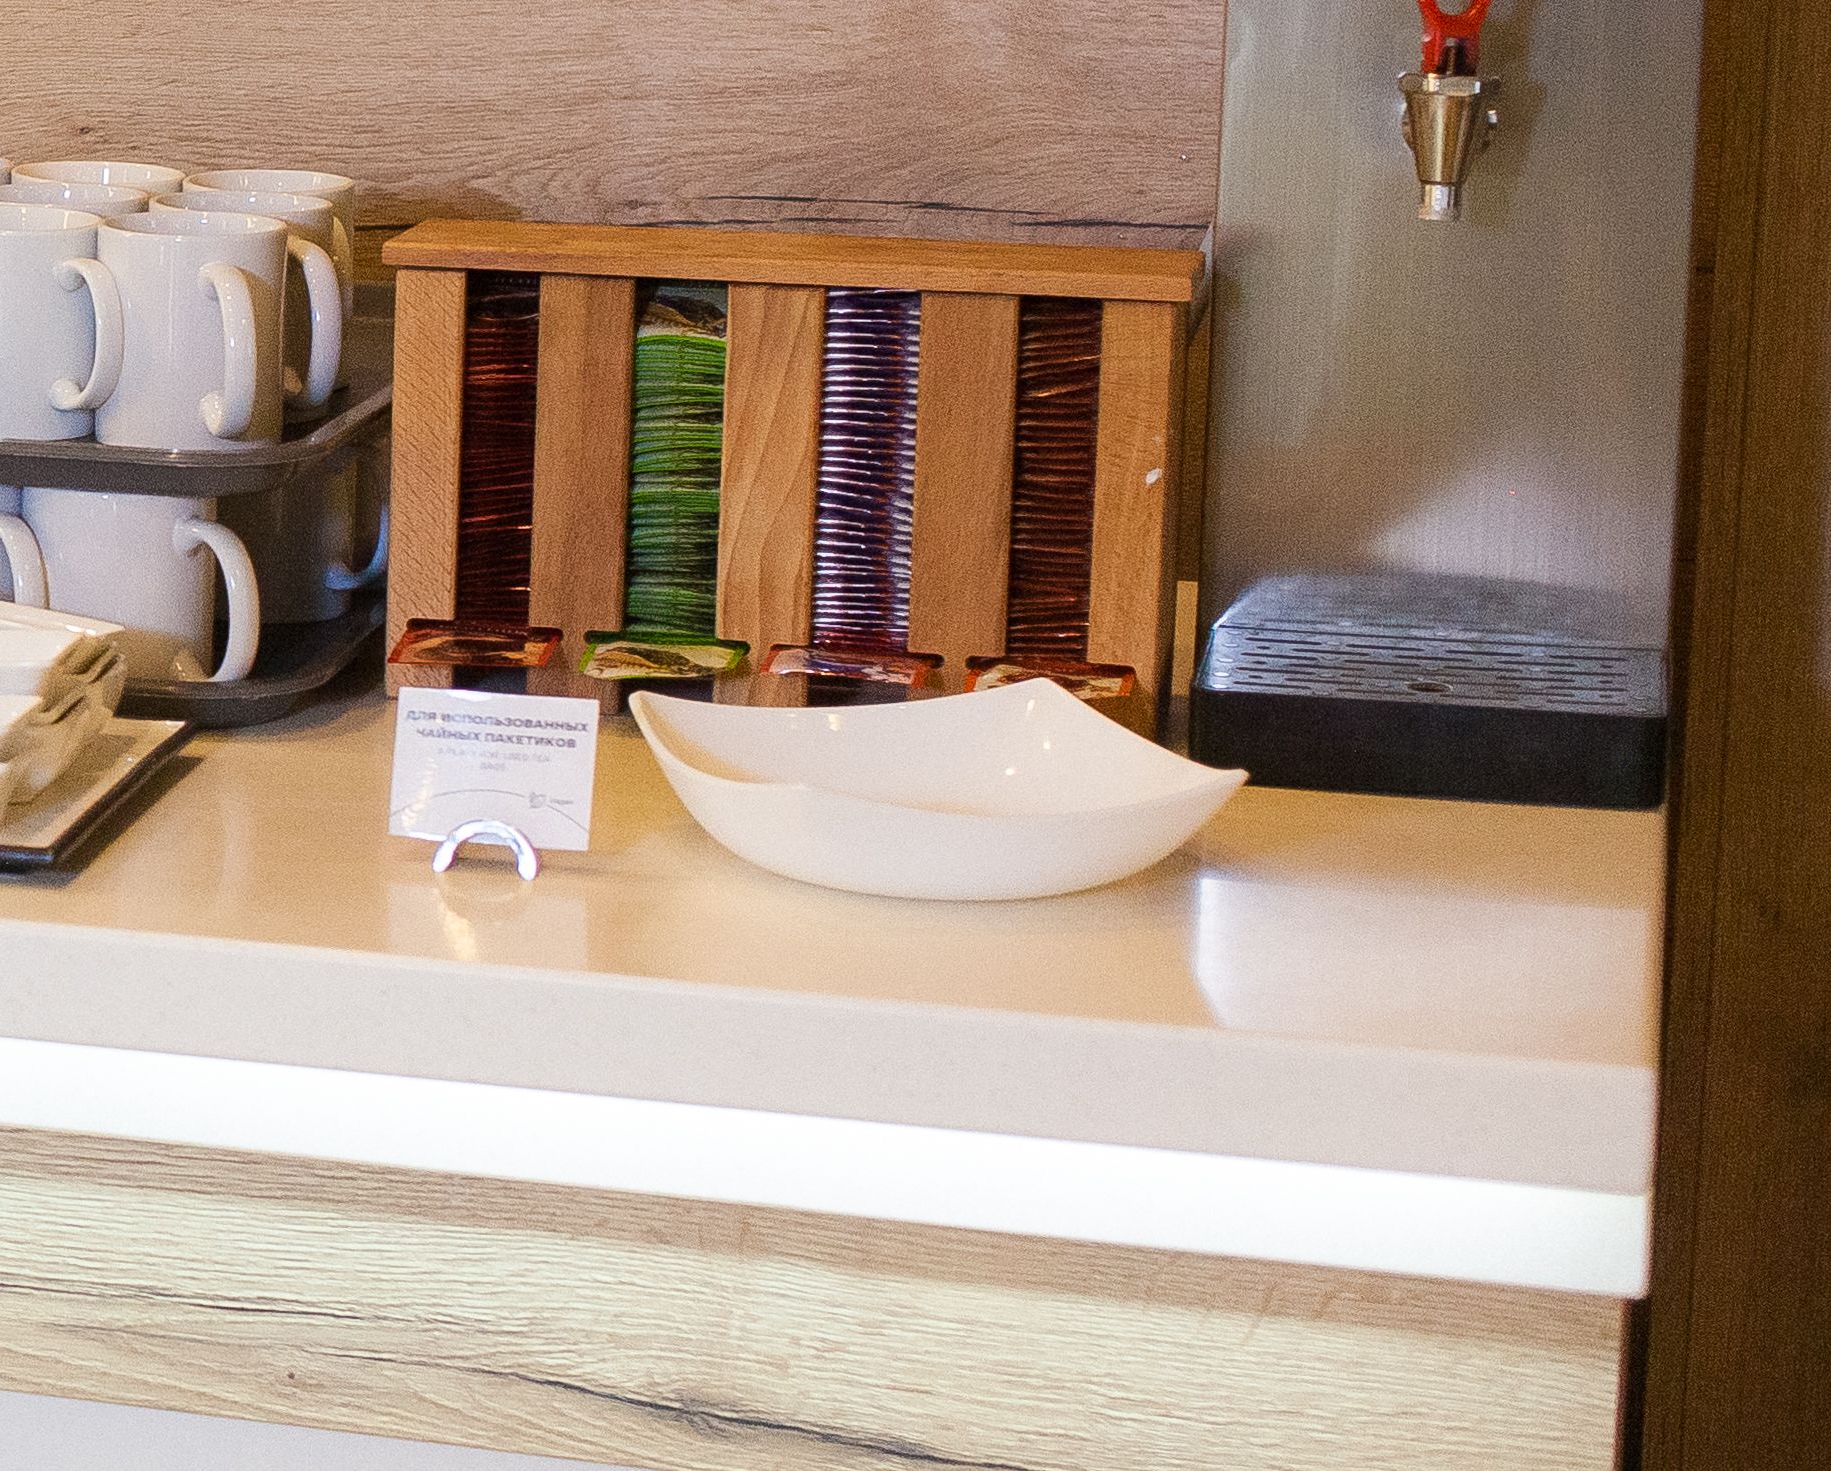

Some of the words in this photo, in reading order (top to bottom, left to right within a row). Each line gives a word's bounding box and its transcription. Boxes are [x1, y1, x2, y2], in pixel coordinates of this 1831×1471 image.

[407, 710, 437, 721] ДЛЯ
[441, 713, 589, 732] ИСПОЛЬЗОВАННЫХ
[416, 727, 480, 741] ЧАЙНЫХ
[484, 733, 577, 748] ПАКЕТИКОВ
